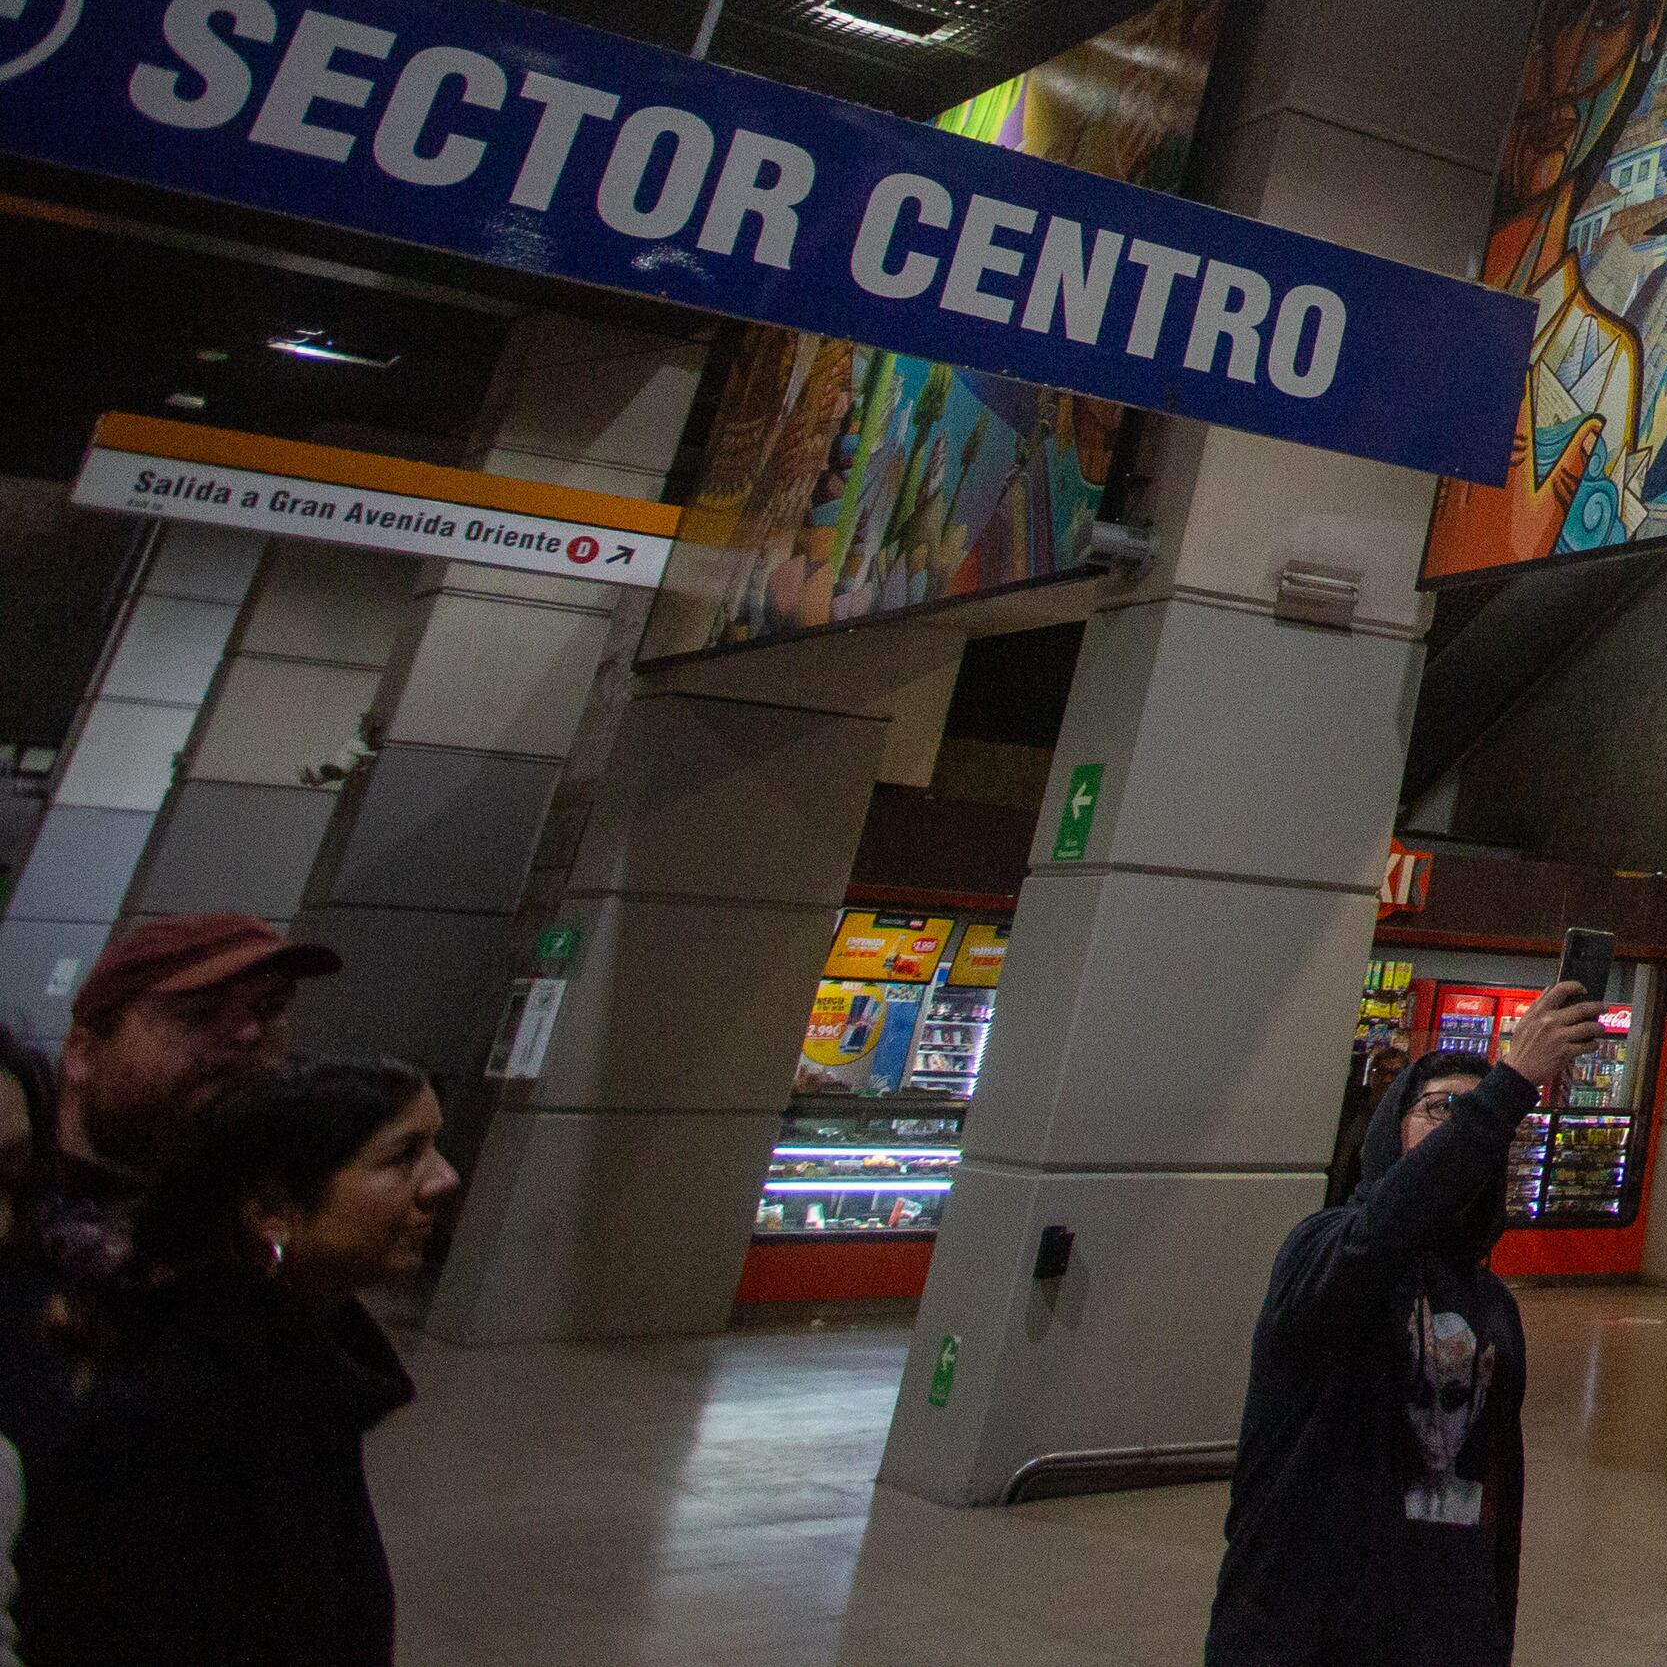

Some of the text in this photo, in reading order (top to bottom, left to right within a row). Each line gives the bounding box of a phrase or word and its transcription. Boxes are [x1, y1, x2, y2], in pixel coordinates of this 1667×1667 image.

[850, 172, 1347, 399] CENTRO
[133, 470, 232, 505] Salida
[240, 489, 260, 509] a
[268, 490, 336, 520] Gran
[344, 501, 456, 538] Avenida
[464, 519, 562, 554] Oriente
